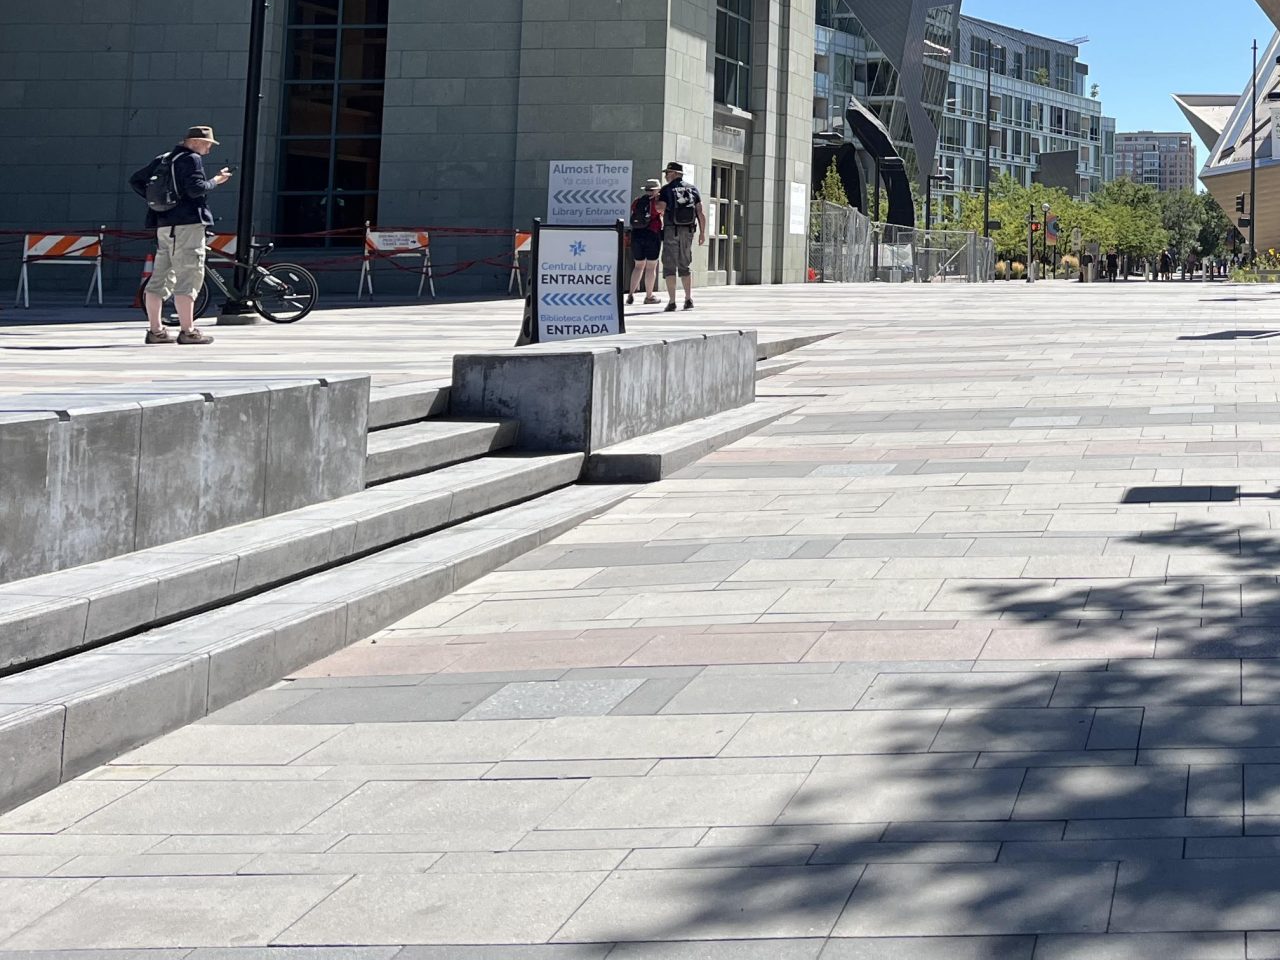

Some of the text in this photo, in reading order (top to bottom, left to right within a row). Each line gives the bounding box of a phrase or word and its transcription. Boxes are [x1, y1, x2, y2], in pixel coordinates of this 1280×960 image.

[553, 163, 629, 174] Almost There
[552, 207, 625, 217] Library Entrance
[541, 262, 612, 273] Central Library
[541, 274, 612, 285] ENTRANCE
[540, 313, 614, 322] Biblioteca Central
[546, 324, 609, 335] ENTRADA
